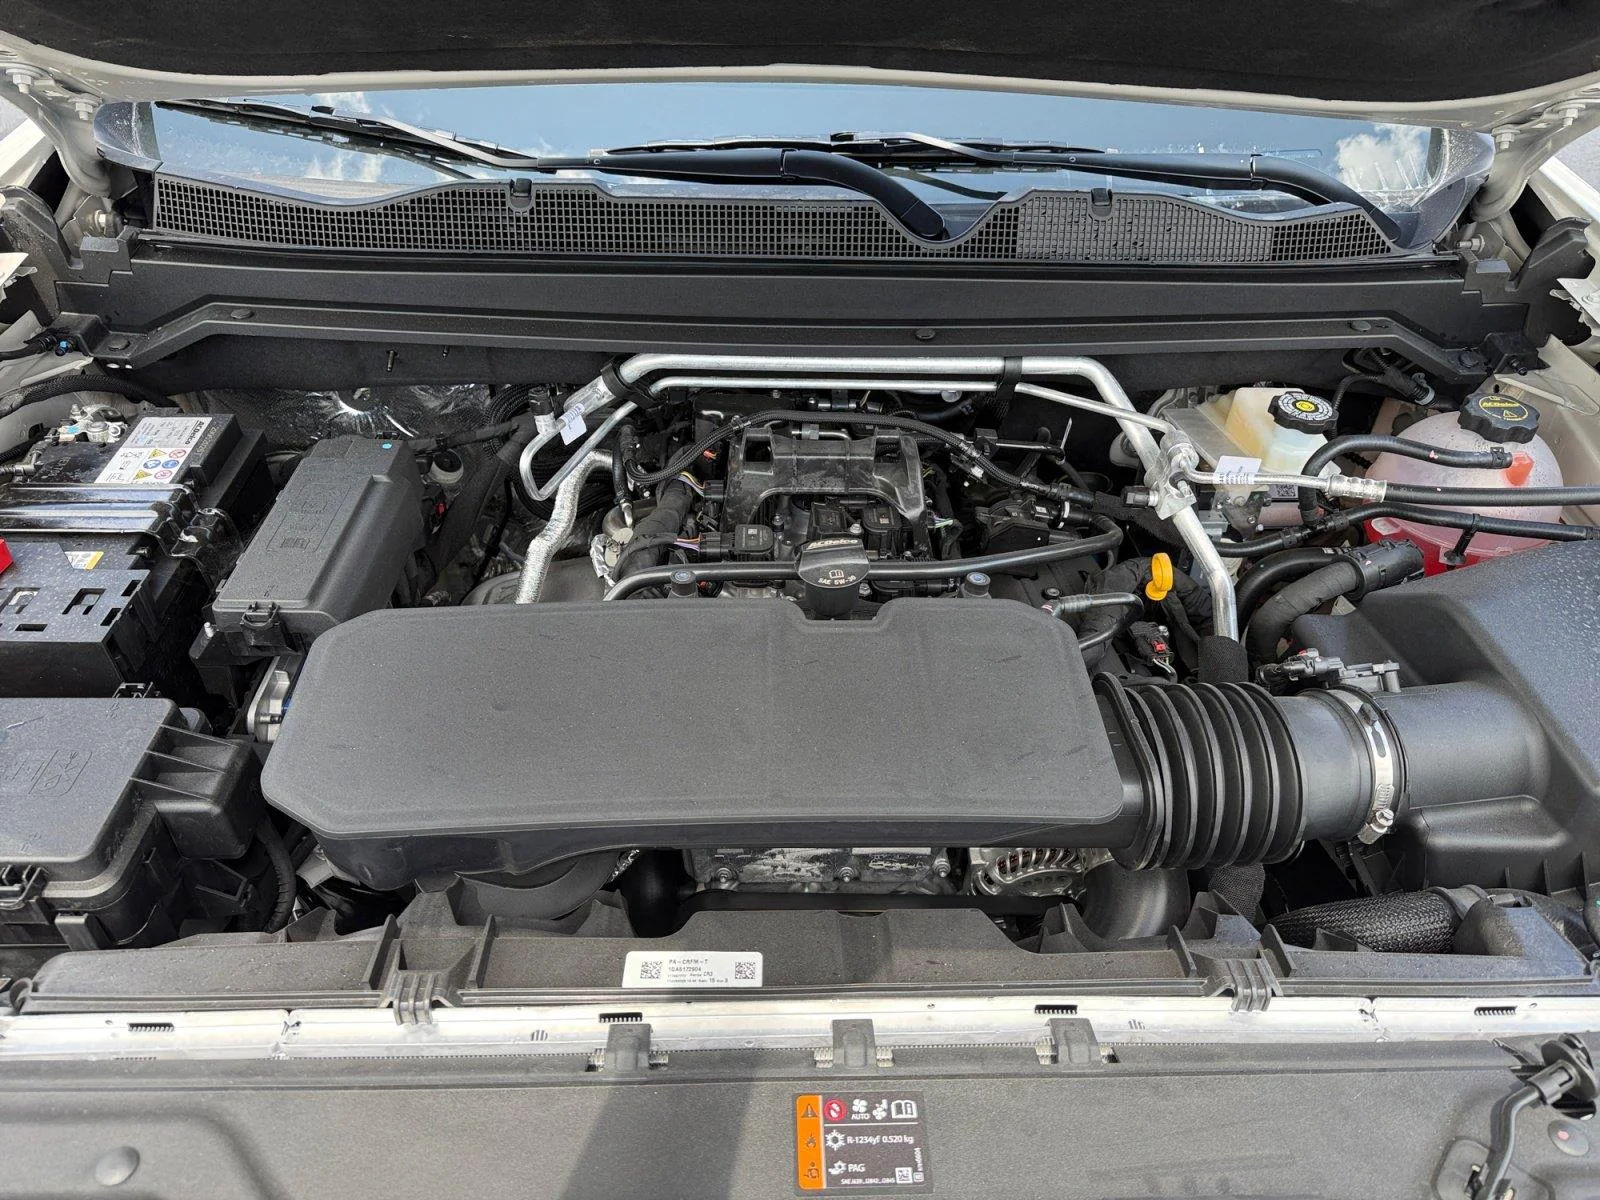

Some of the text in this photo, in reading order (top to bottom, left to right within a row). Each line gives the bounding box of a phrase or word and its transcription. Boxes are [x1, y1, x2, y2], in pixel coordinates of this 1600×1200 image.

[184, 420, 205, 445] ACDelco
[806, 539, 858, 550] ACDelco
[818, 575, 857, 585] SAE 5W-30
[847, 1134, 914, 1145] R-1234yf 0.520 kg
[848, 1163, 866, 1172] PAG
